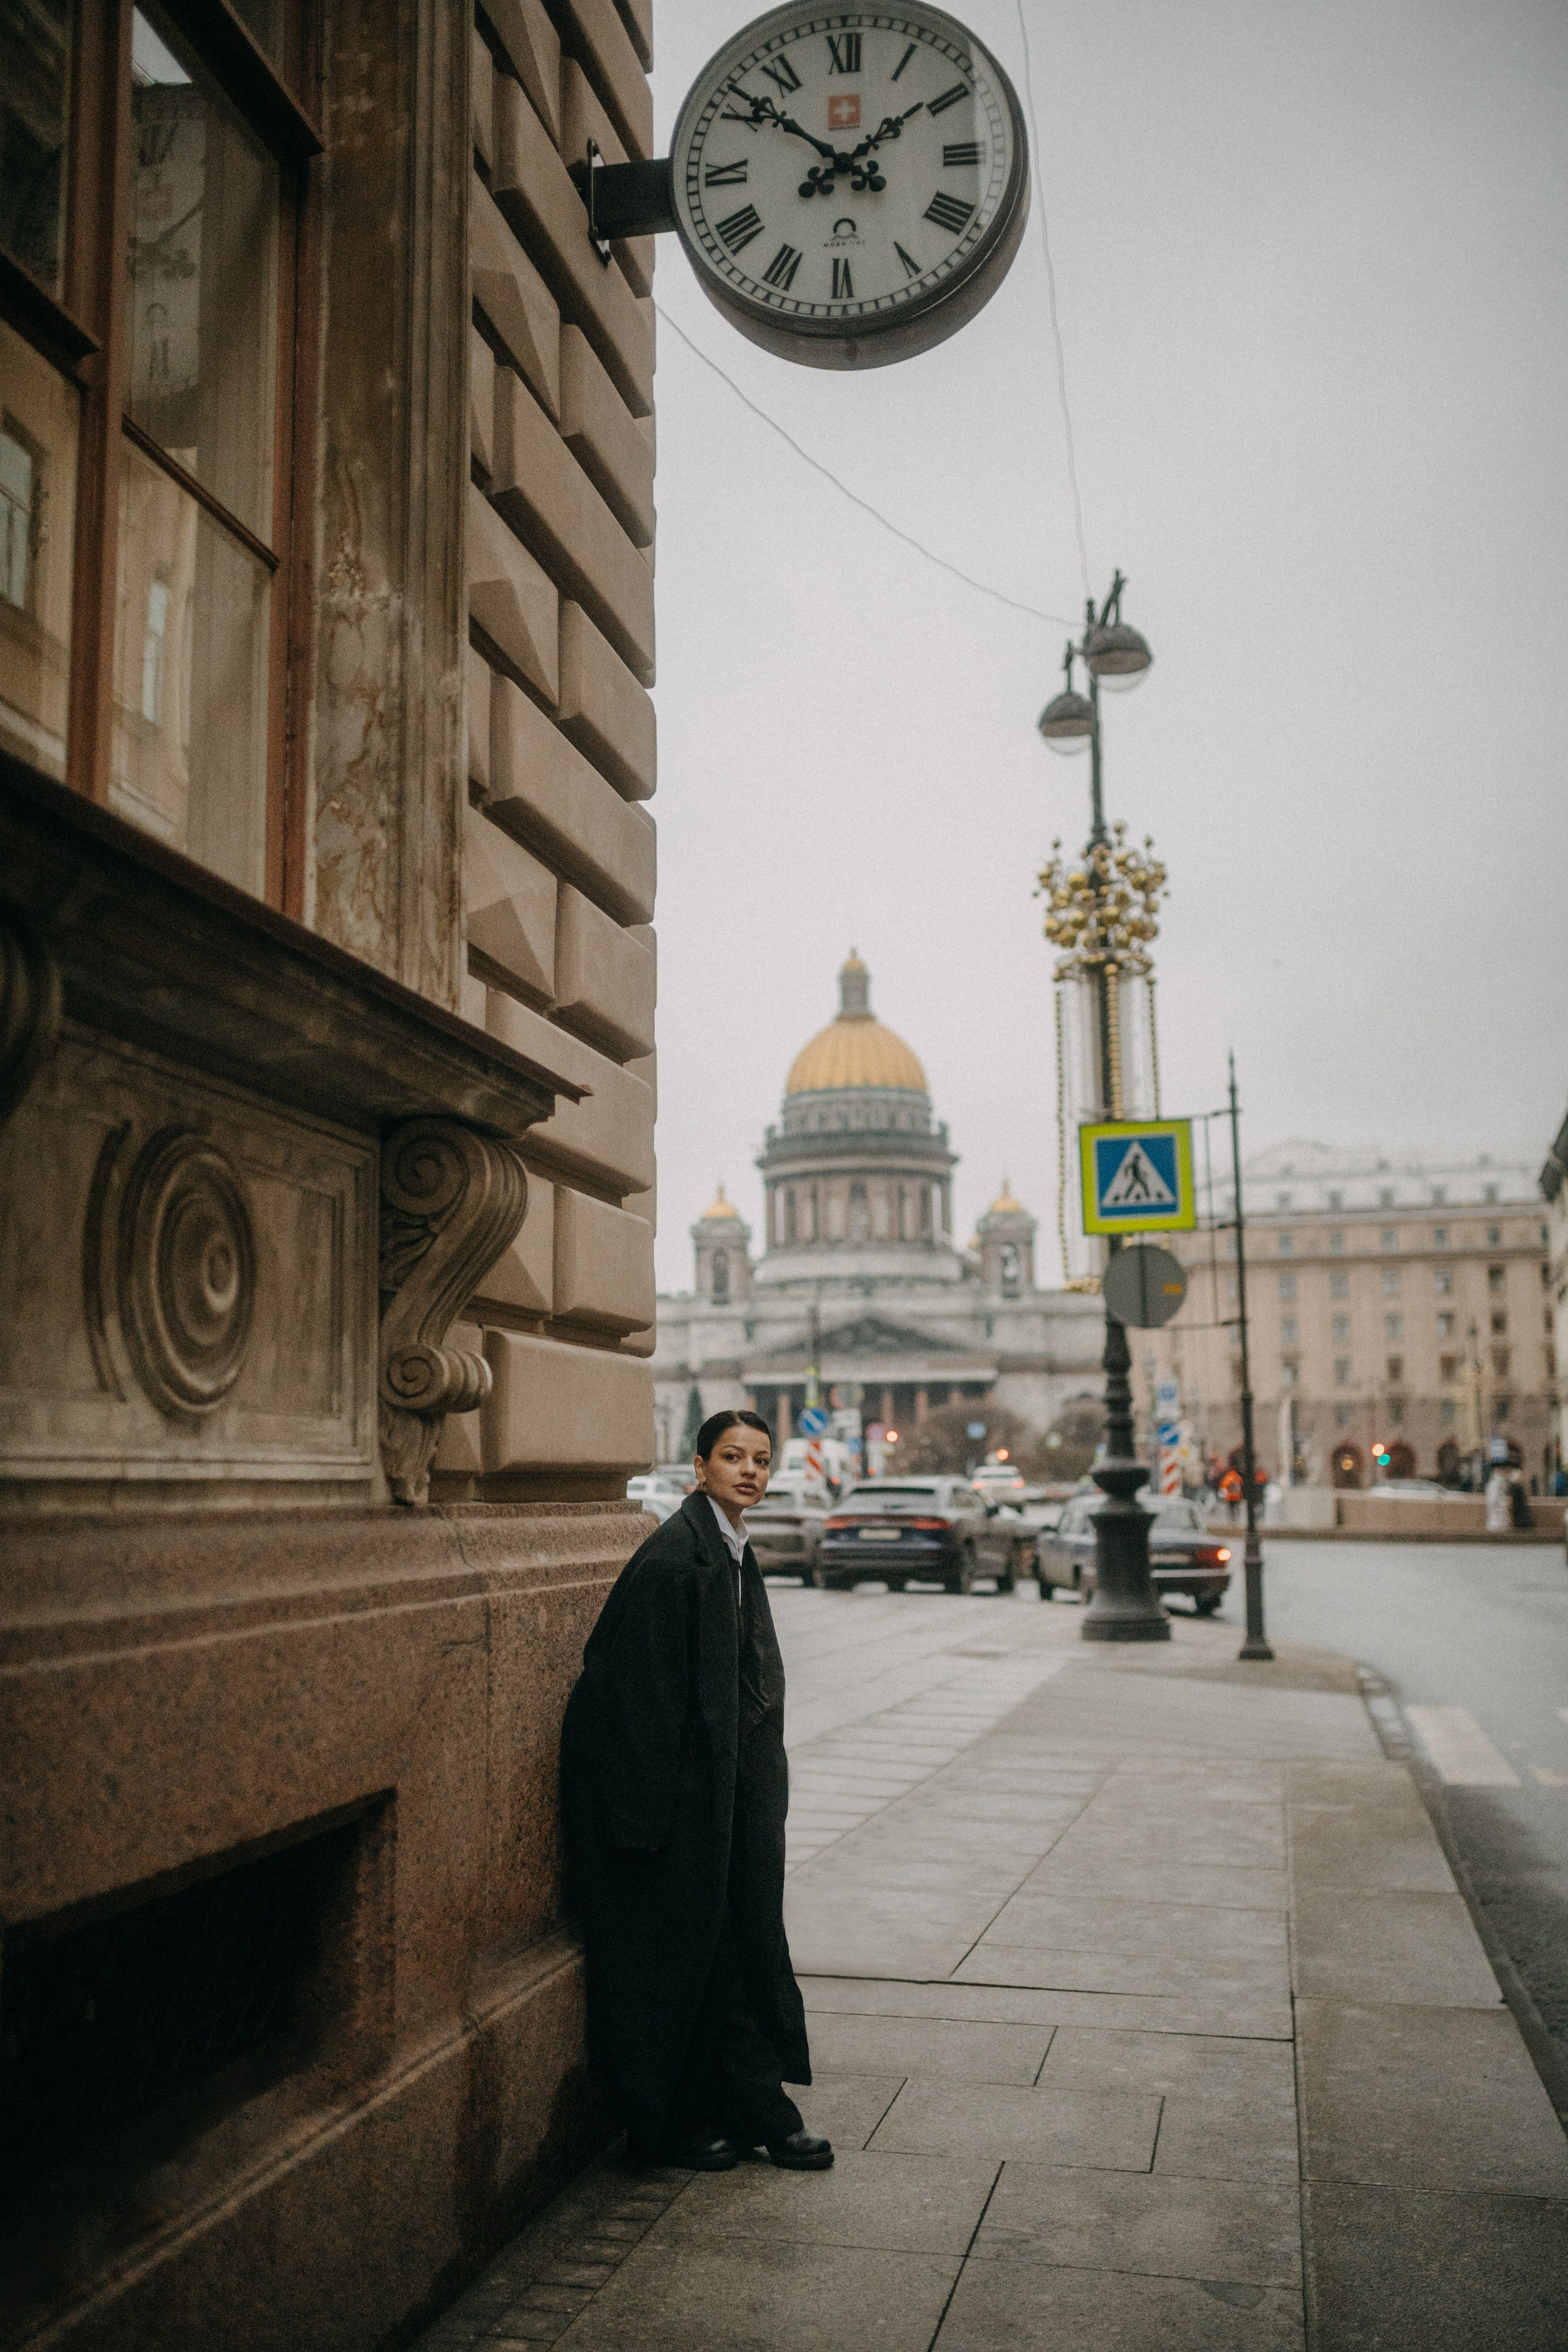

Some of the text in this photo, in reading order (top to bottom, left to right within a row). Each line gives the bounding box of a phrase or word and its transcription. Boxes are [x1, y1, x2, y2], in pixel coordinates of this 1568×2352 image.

[826, 32, 863, 75] XII
[891, 43, 918, 81] I
[761, 53, 802, 98] XI
[720, 103, 765, 134] X
[926, 81, 970, 116] II
[705, 159, 748, 187] IX
[943, 141, 986, 167] III
[715, 203, 765, 256] VIII
[923, 190, 976, 236] IIII
[762, 243, 803, 292] VII
[831, 257, 854, 300] VI
[893, 240, 922, 279] V
